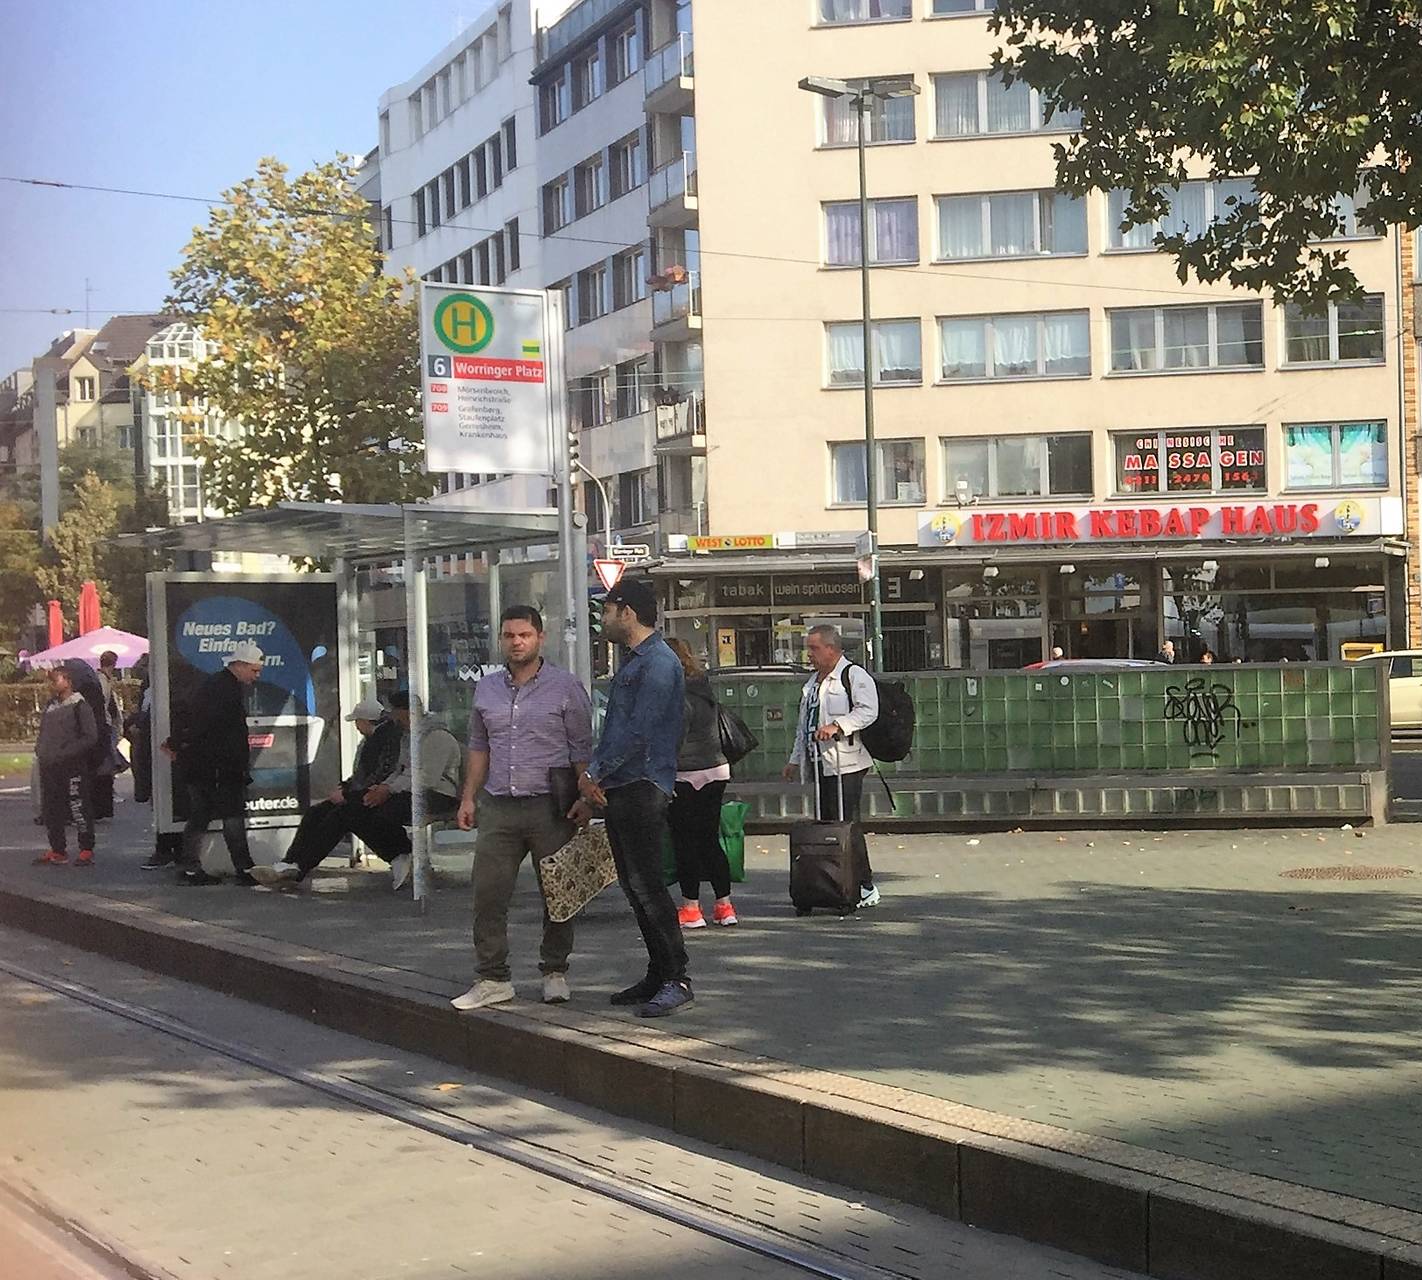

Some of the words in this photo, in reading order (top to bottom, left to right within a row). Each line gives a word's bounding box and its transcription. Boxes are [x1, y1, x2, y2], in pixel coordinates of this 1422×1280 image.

[452, 307, 477, 341] H
[434, 358, 446, 376] 6
[455, 362, 512, 379] Worringer
[515, 365, 543, 378] Platz
[459, 431, 508, 440] Krankenhaus
[1136, 435, 1235, 450] CHINESISCHE
[1123, 449, 1265, 471] MASSAGEN
[971, 511, 1079, 542] IZMIR
[1089, 507, 1211, 539] KEBAP
[1220, 503, 1321, 535] HAUS
[695, 537, 722, 548] WEST
[734, 536, 765, 547] LOTTO
[721, 584, 765, 597] tabak
[774, 584, 800, 596] wein
[802, 583, 861, 598] spirituosen
[182, 621, 232, 636] Neues
[236, 620, 276, 635] Bad?
